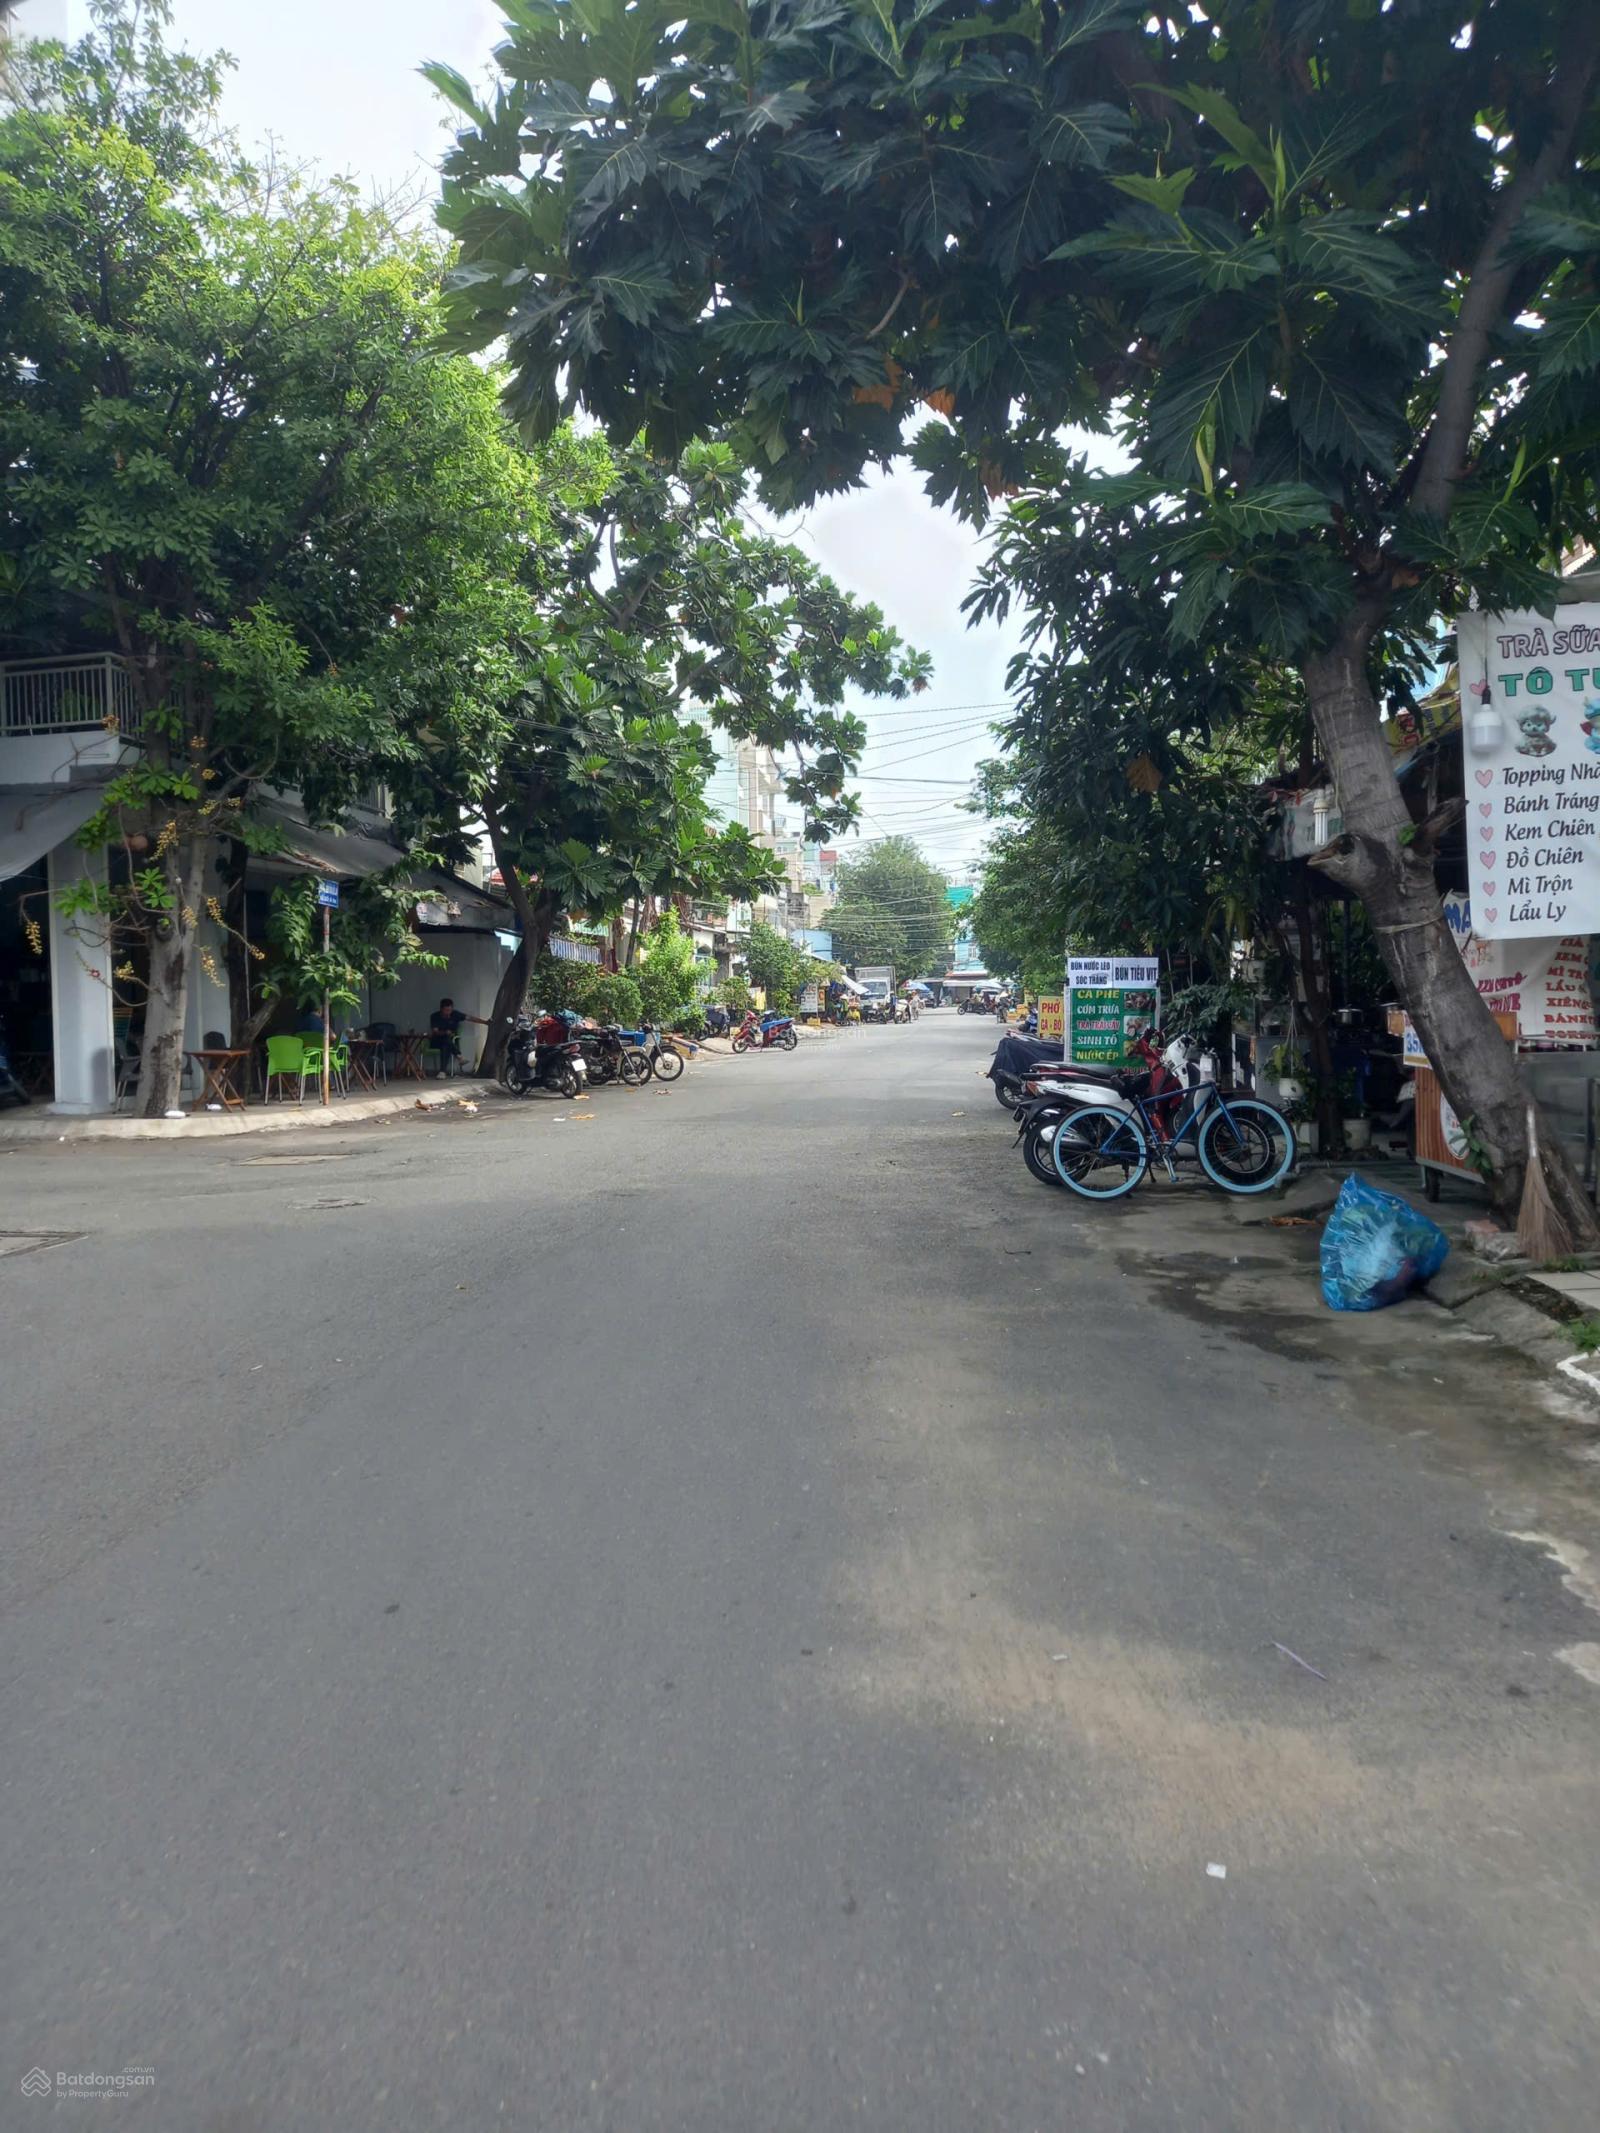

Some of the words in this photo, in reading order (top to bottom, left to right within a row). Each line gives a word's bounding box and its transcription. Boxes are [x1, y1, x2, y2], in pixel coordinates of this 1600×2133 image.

[1497, 627, 1549, 659] TRÀ
[1498, 666, 1553, 696] TÔ
[1502, 764, 1565, 788] Topping
[1504, 794, 1549, 814] Bánh
[1555, 792, 1600, 812] Tráng
[1505, 823, 1542, 841] Kem
[1548, 818, 1595, 838] Chiên
[1506, 846, 1529, 869] Đồ
[1534, 846, 1584, 867] Chiên
[1507, 876, 1531, 896] Mì
[1536, 874, 1573, 896] Trộn
[1509, 899, 1541, 922] Lẩu
[1547, 901, 1567, 922] Ly
[1077, 1004, 1096, 1015] CƠM
[1077, 1035, 1102, 1045] SINH
